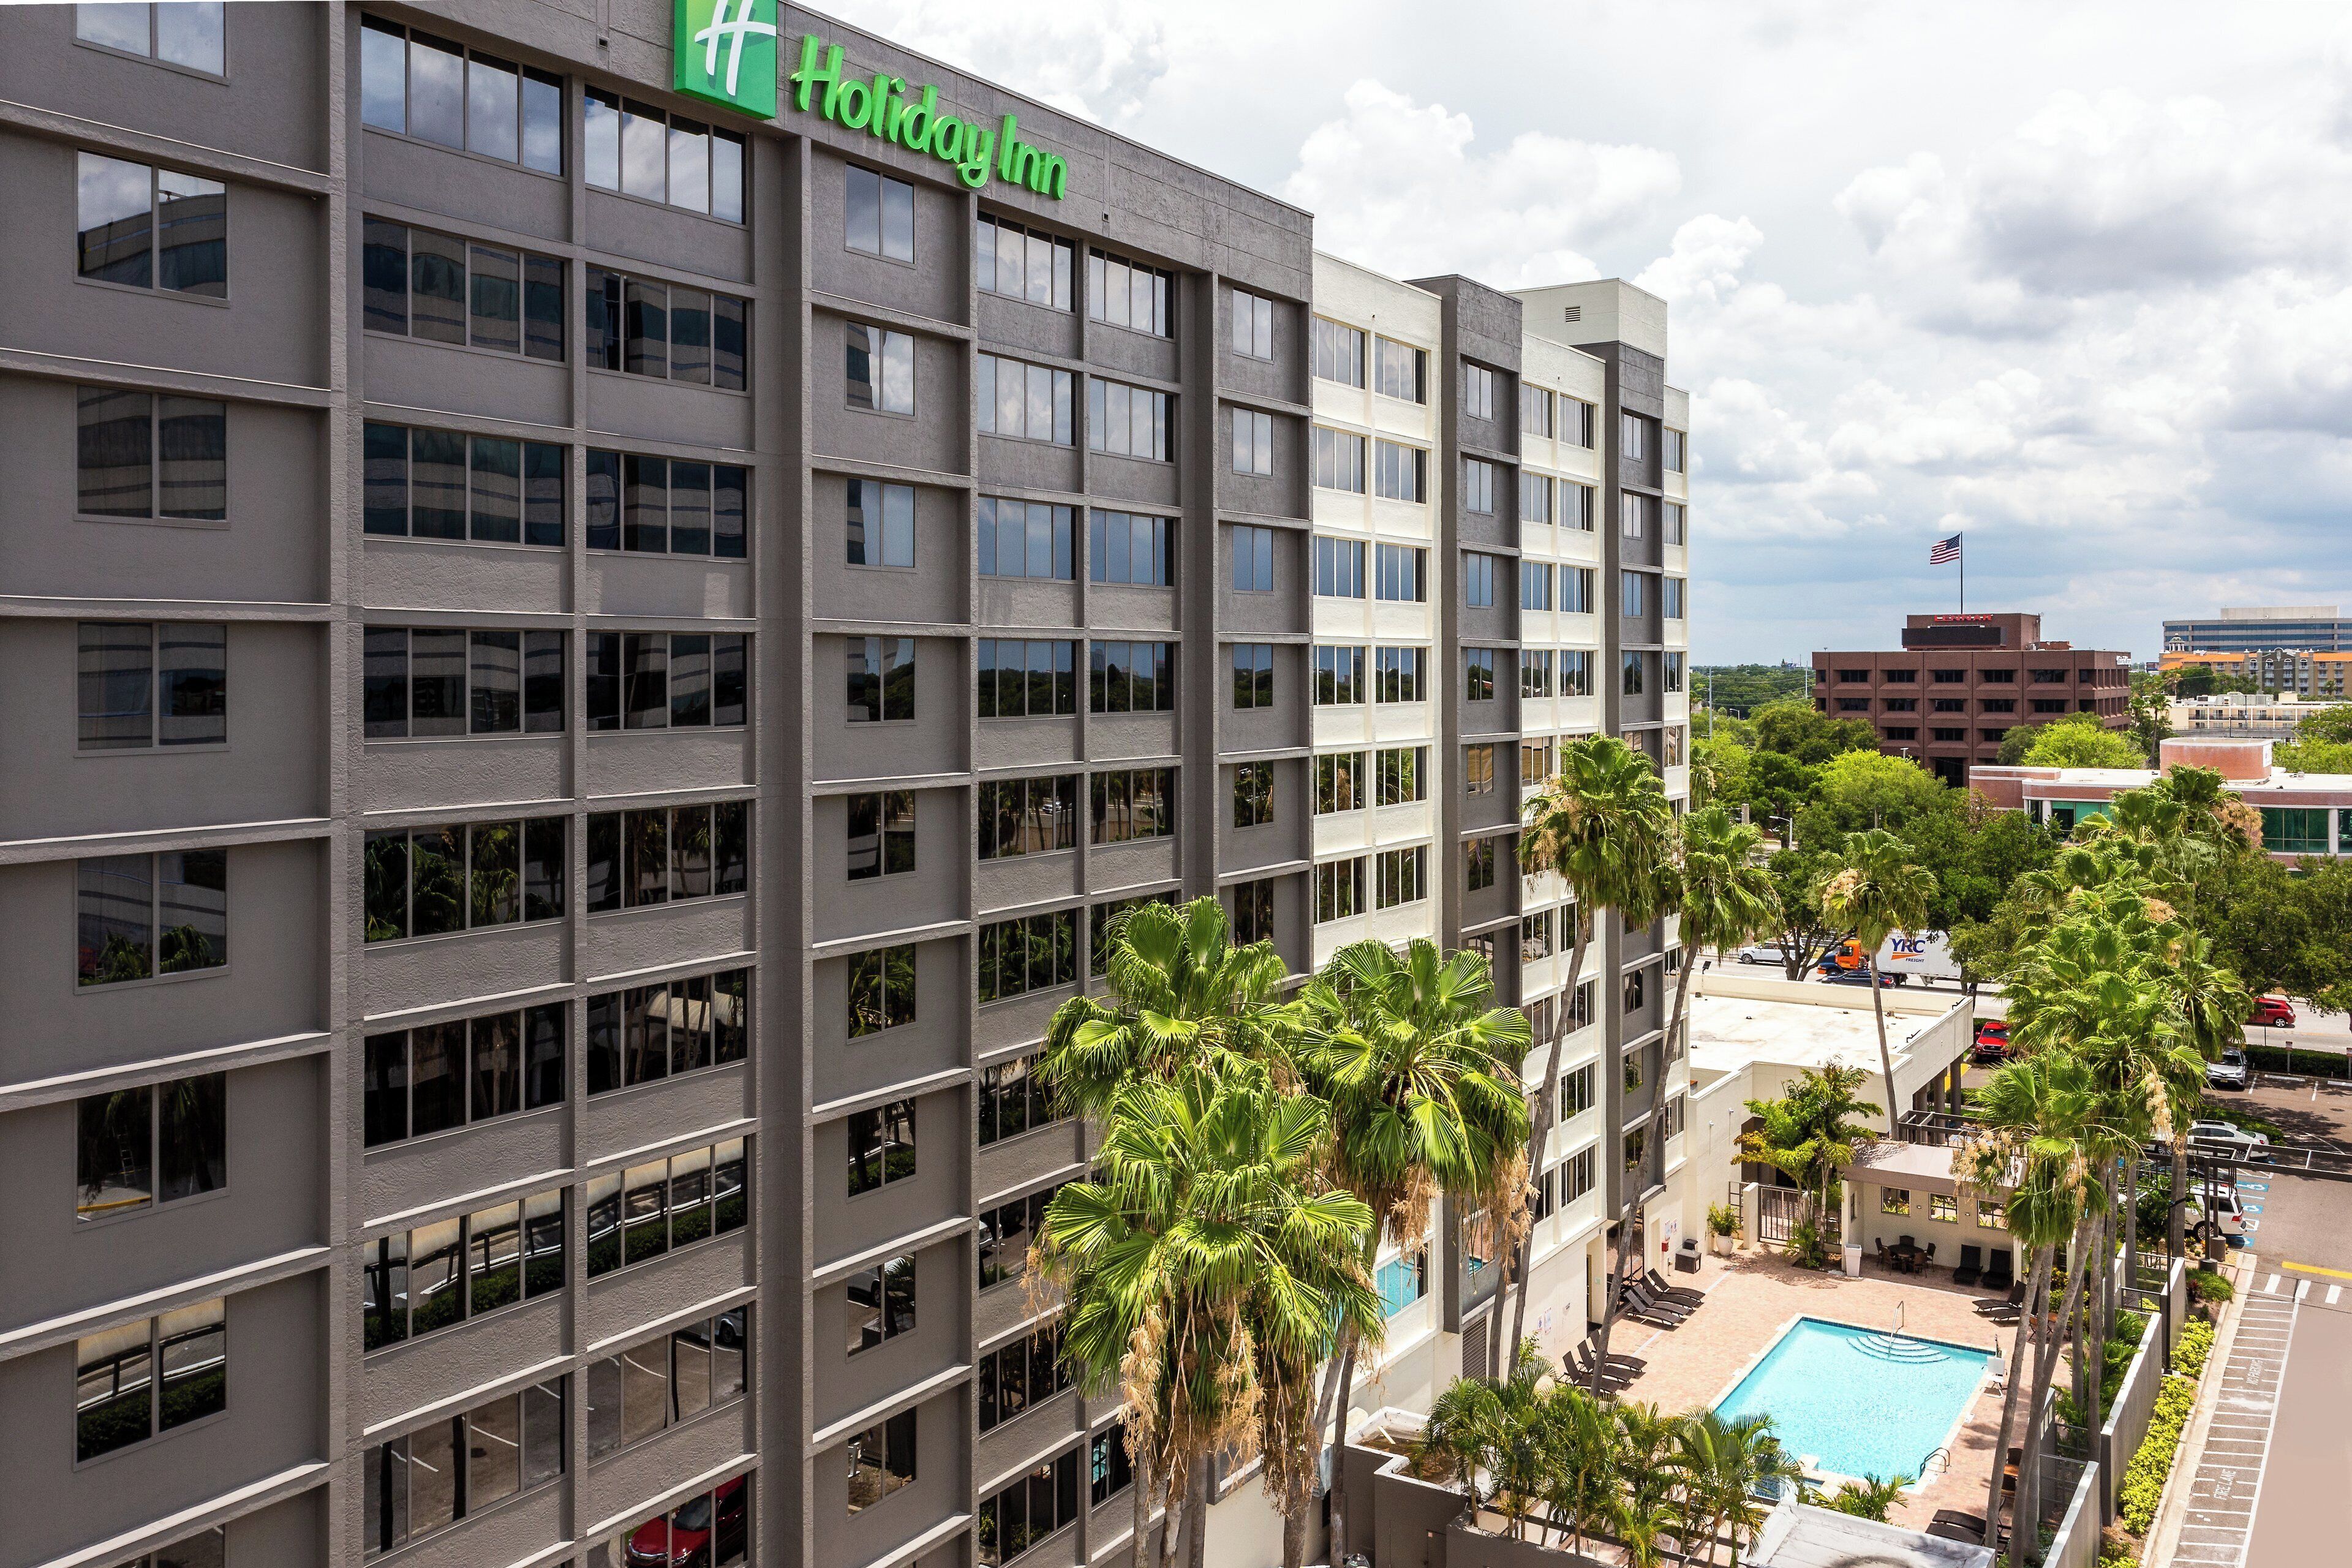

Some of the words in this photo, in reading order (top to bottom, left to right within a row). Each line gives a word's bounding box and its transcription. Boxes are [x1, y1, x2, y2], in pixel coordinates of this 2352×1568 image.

[790, 34, 995, 188] Holiday
[997, 113, 1068, 200] Inn
[1891, 938, 1926, 953] YRC
[2218, 1469, 2236, 1485] LANE
[2214, 1484, 2231, 1500] FIRE
